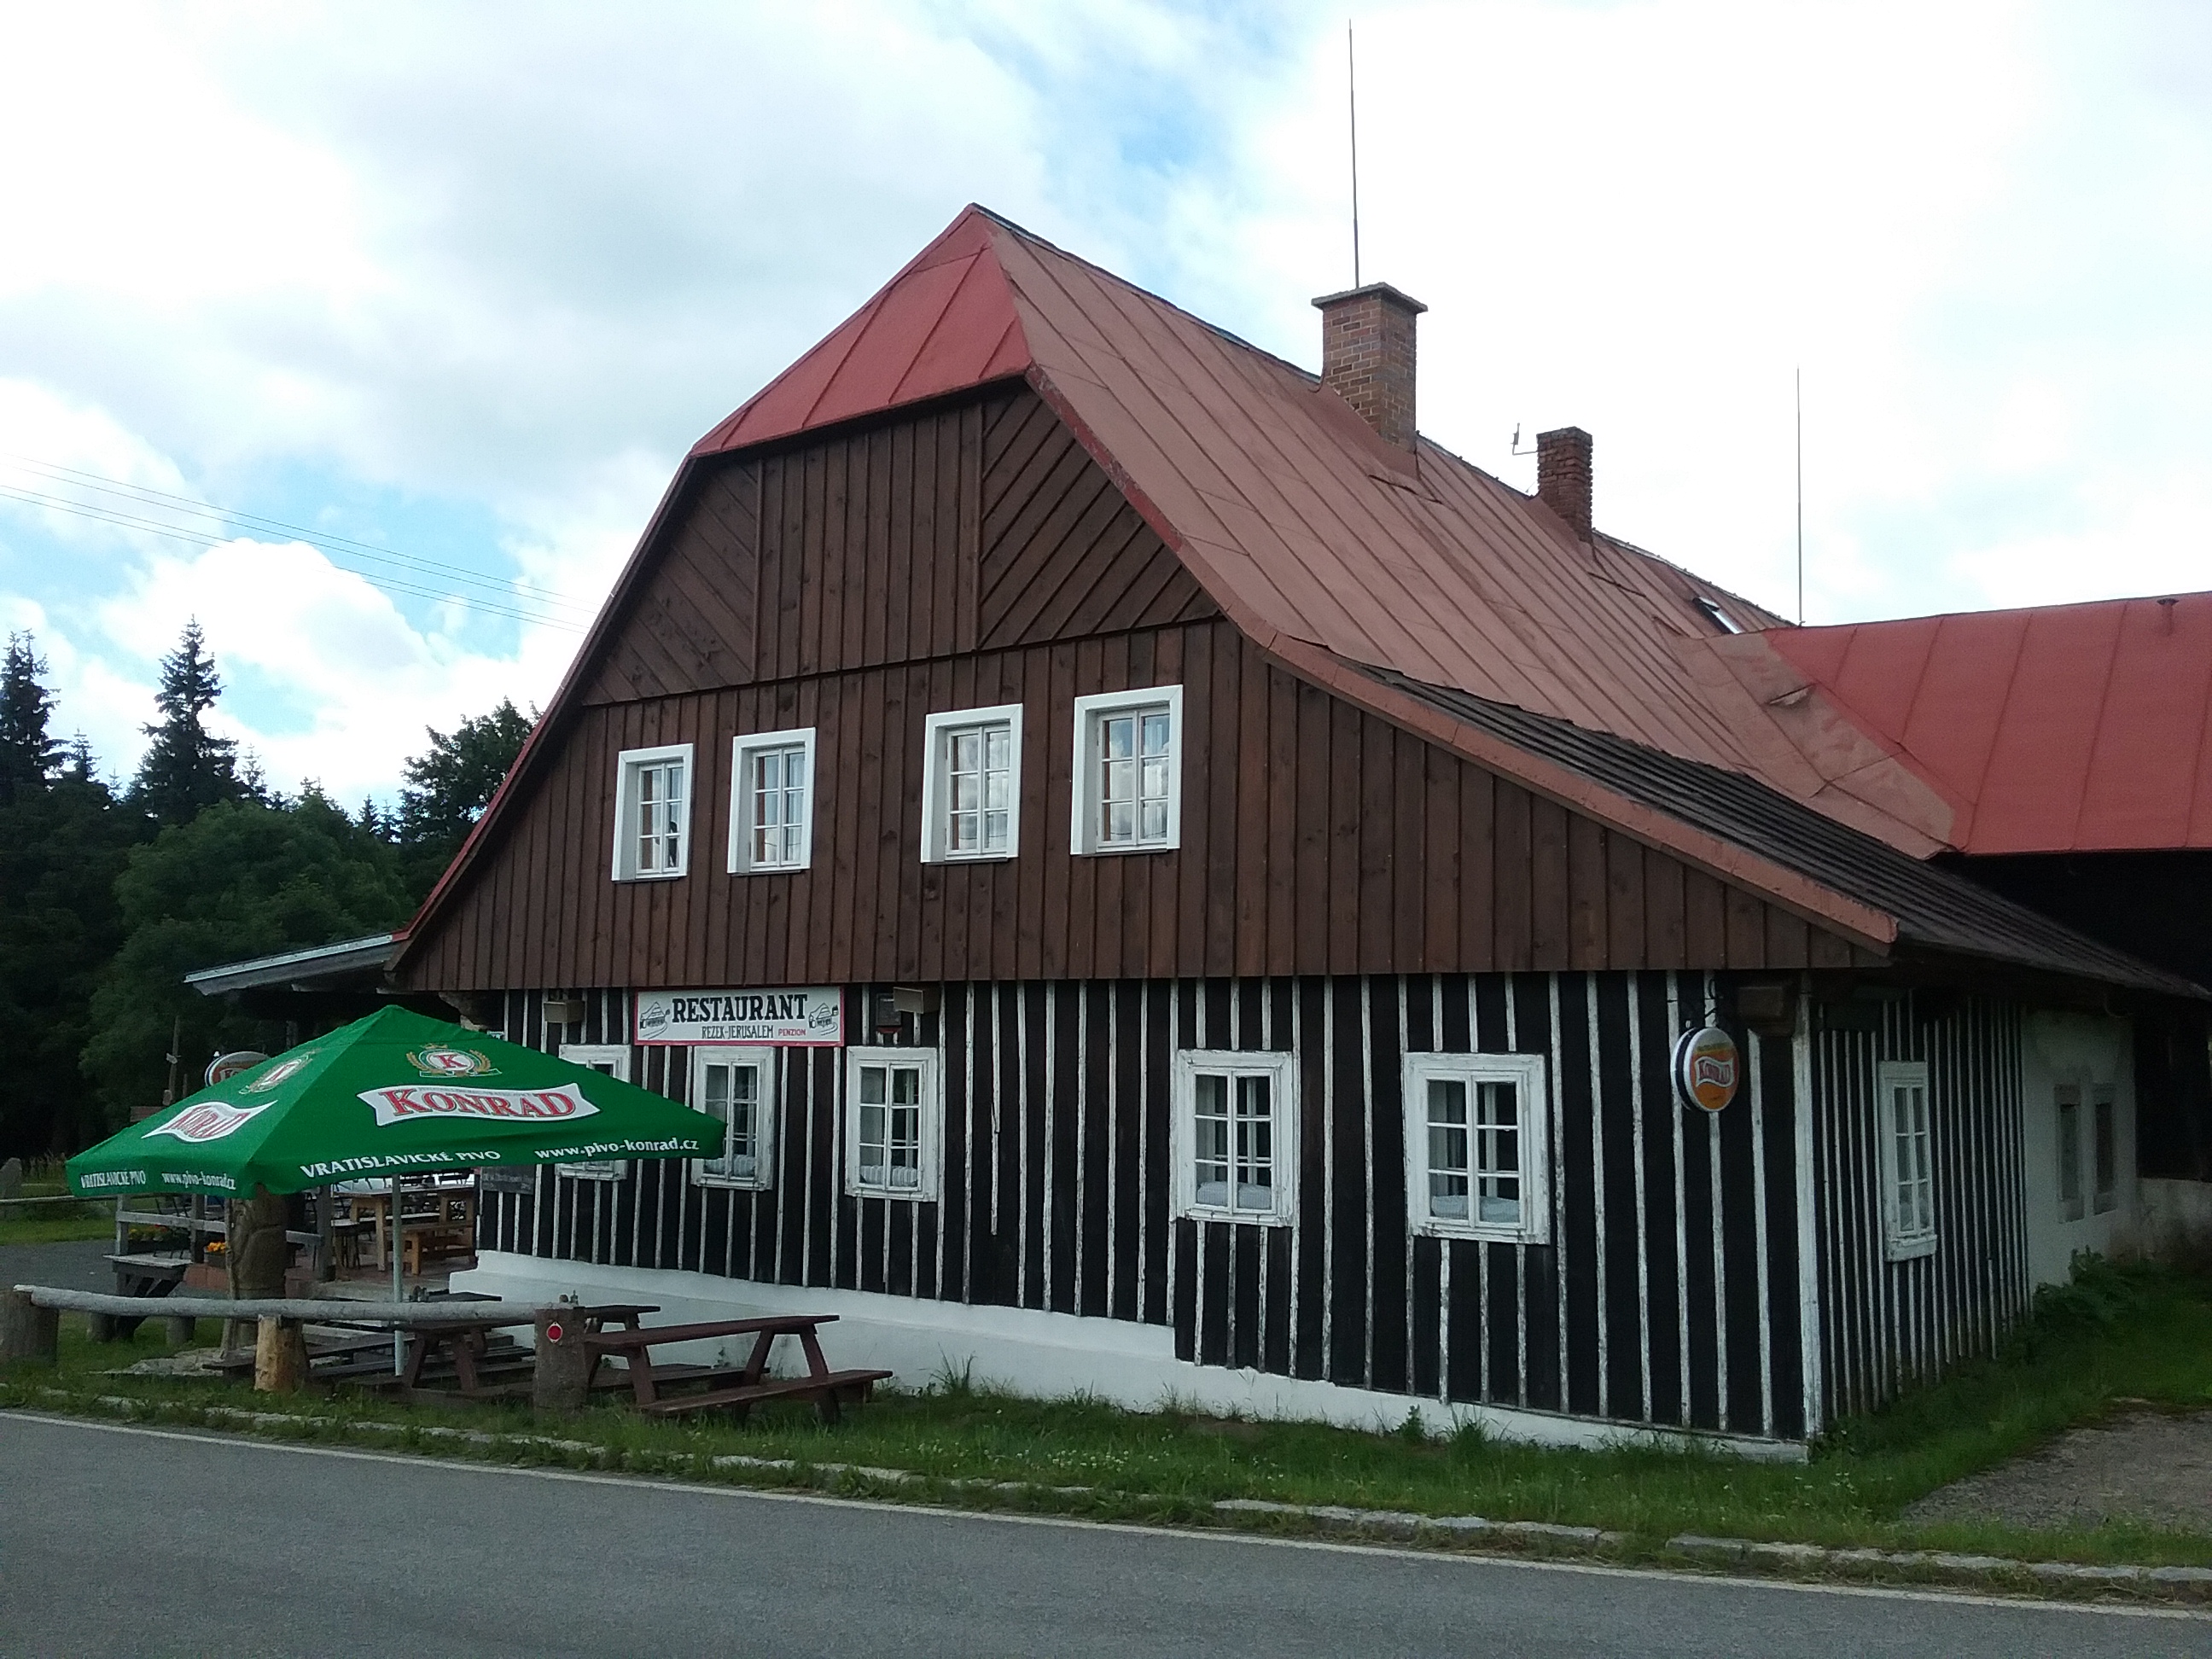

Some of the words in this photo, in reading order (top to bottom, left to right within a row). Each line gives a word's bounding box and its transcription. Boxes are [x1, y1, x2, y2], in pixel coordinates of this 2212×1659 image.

[672, 993, 808, 1023] RESTAURANT
[701, 1025, 774, 1039] REZEK-JERUSALEM
[777, 1027, 806, 1037] PENZION
[434, 1053, 468, 1068] K
[379, 1088, 576, 1118] KONRAD
[534, 1137, 700, 1159] www.pivo-konrad.cz
[161, 1170, 236, 1190] www.pivo-konrad.cz
